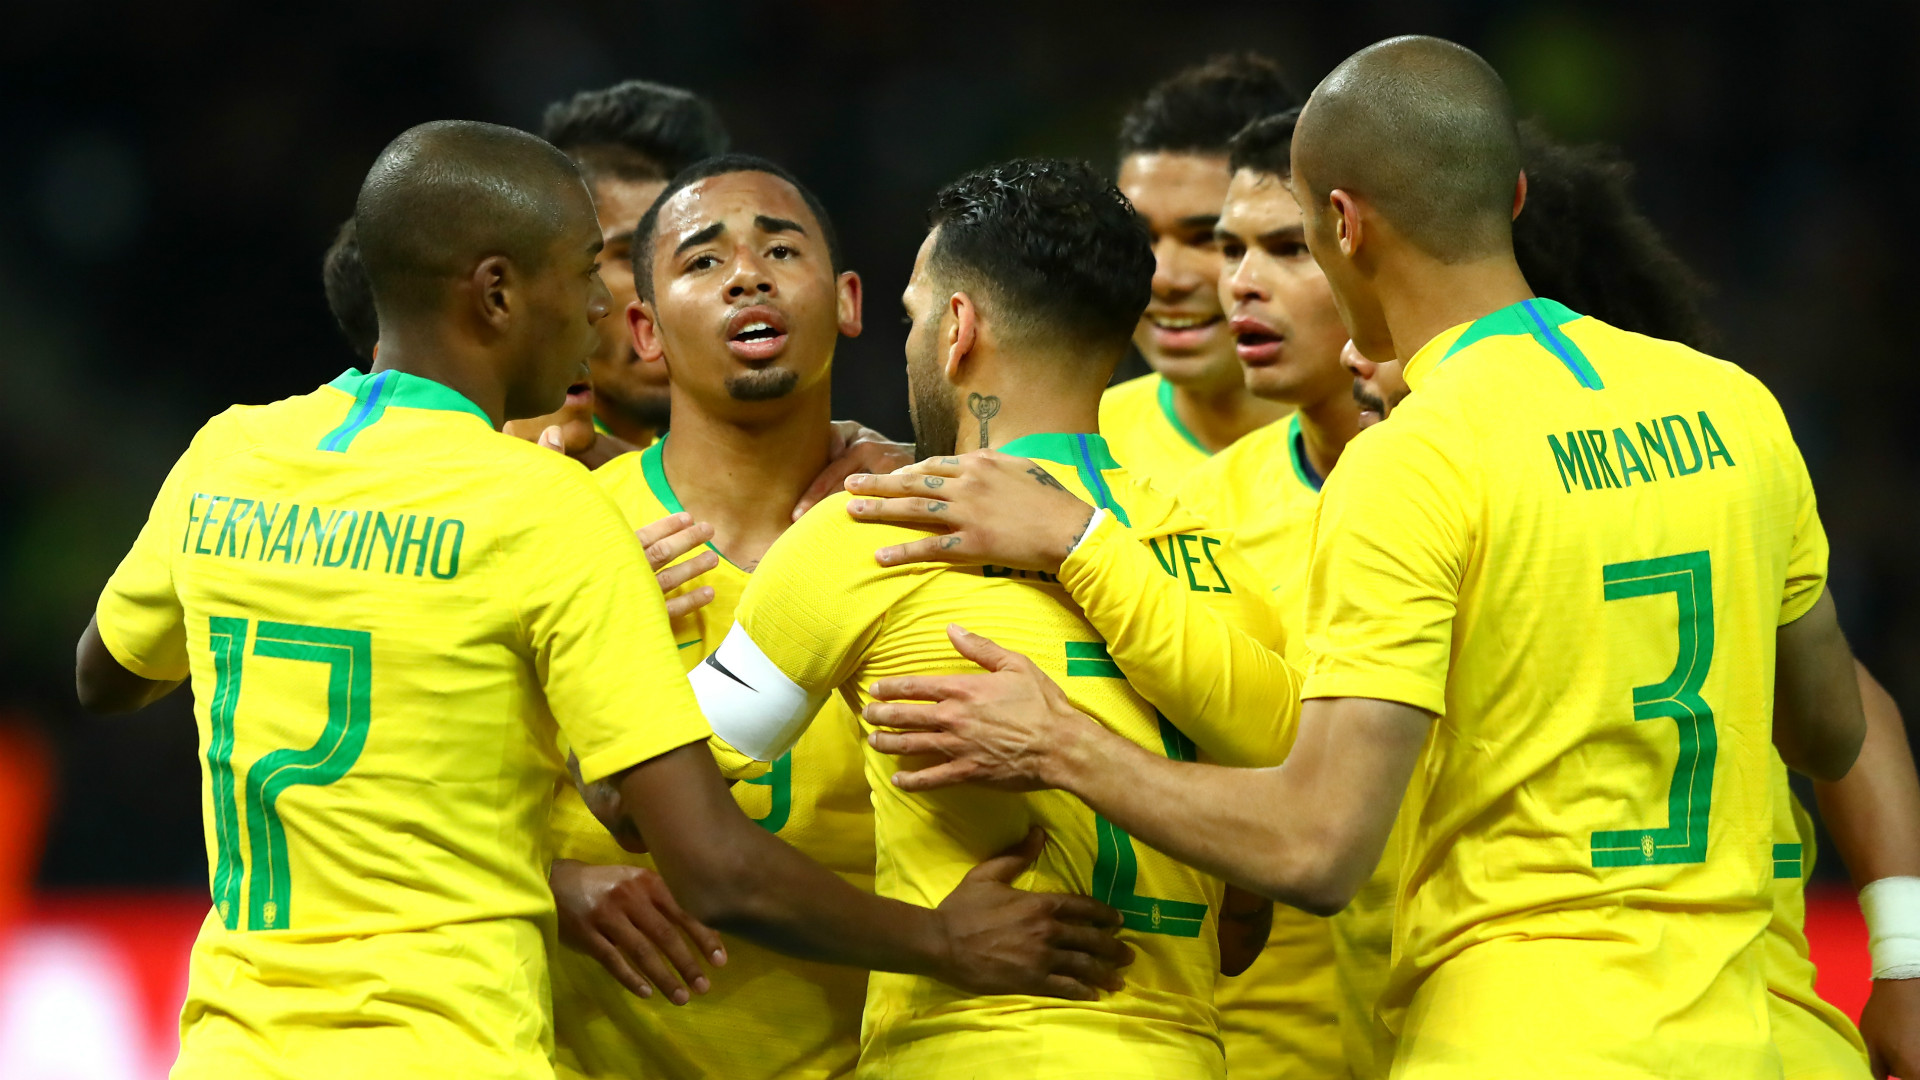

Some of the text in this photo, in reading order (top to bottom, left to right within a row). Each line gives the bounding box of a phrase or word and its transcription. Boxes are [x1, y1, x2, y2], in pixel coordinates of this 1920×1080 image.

[1547, 411, 1736, 494] MIRANDA
[182, 492, 465, 580] FERNANDINHO
[1149, 533, 1232, 594] VES
[1590, 550, 1718, 868] 3
[207, 615, 372, 932] 17
